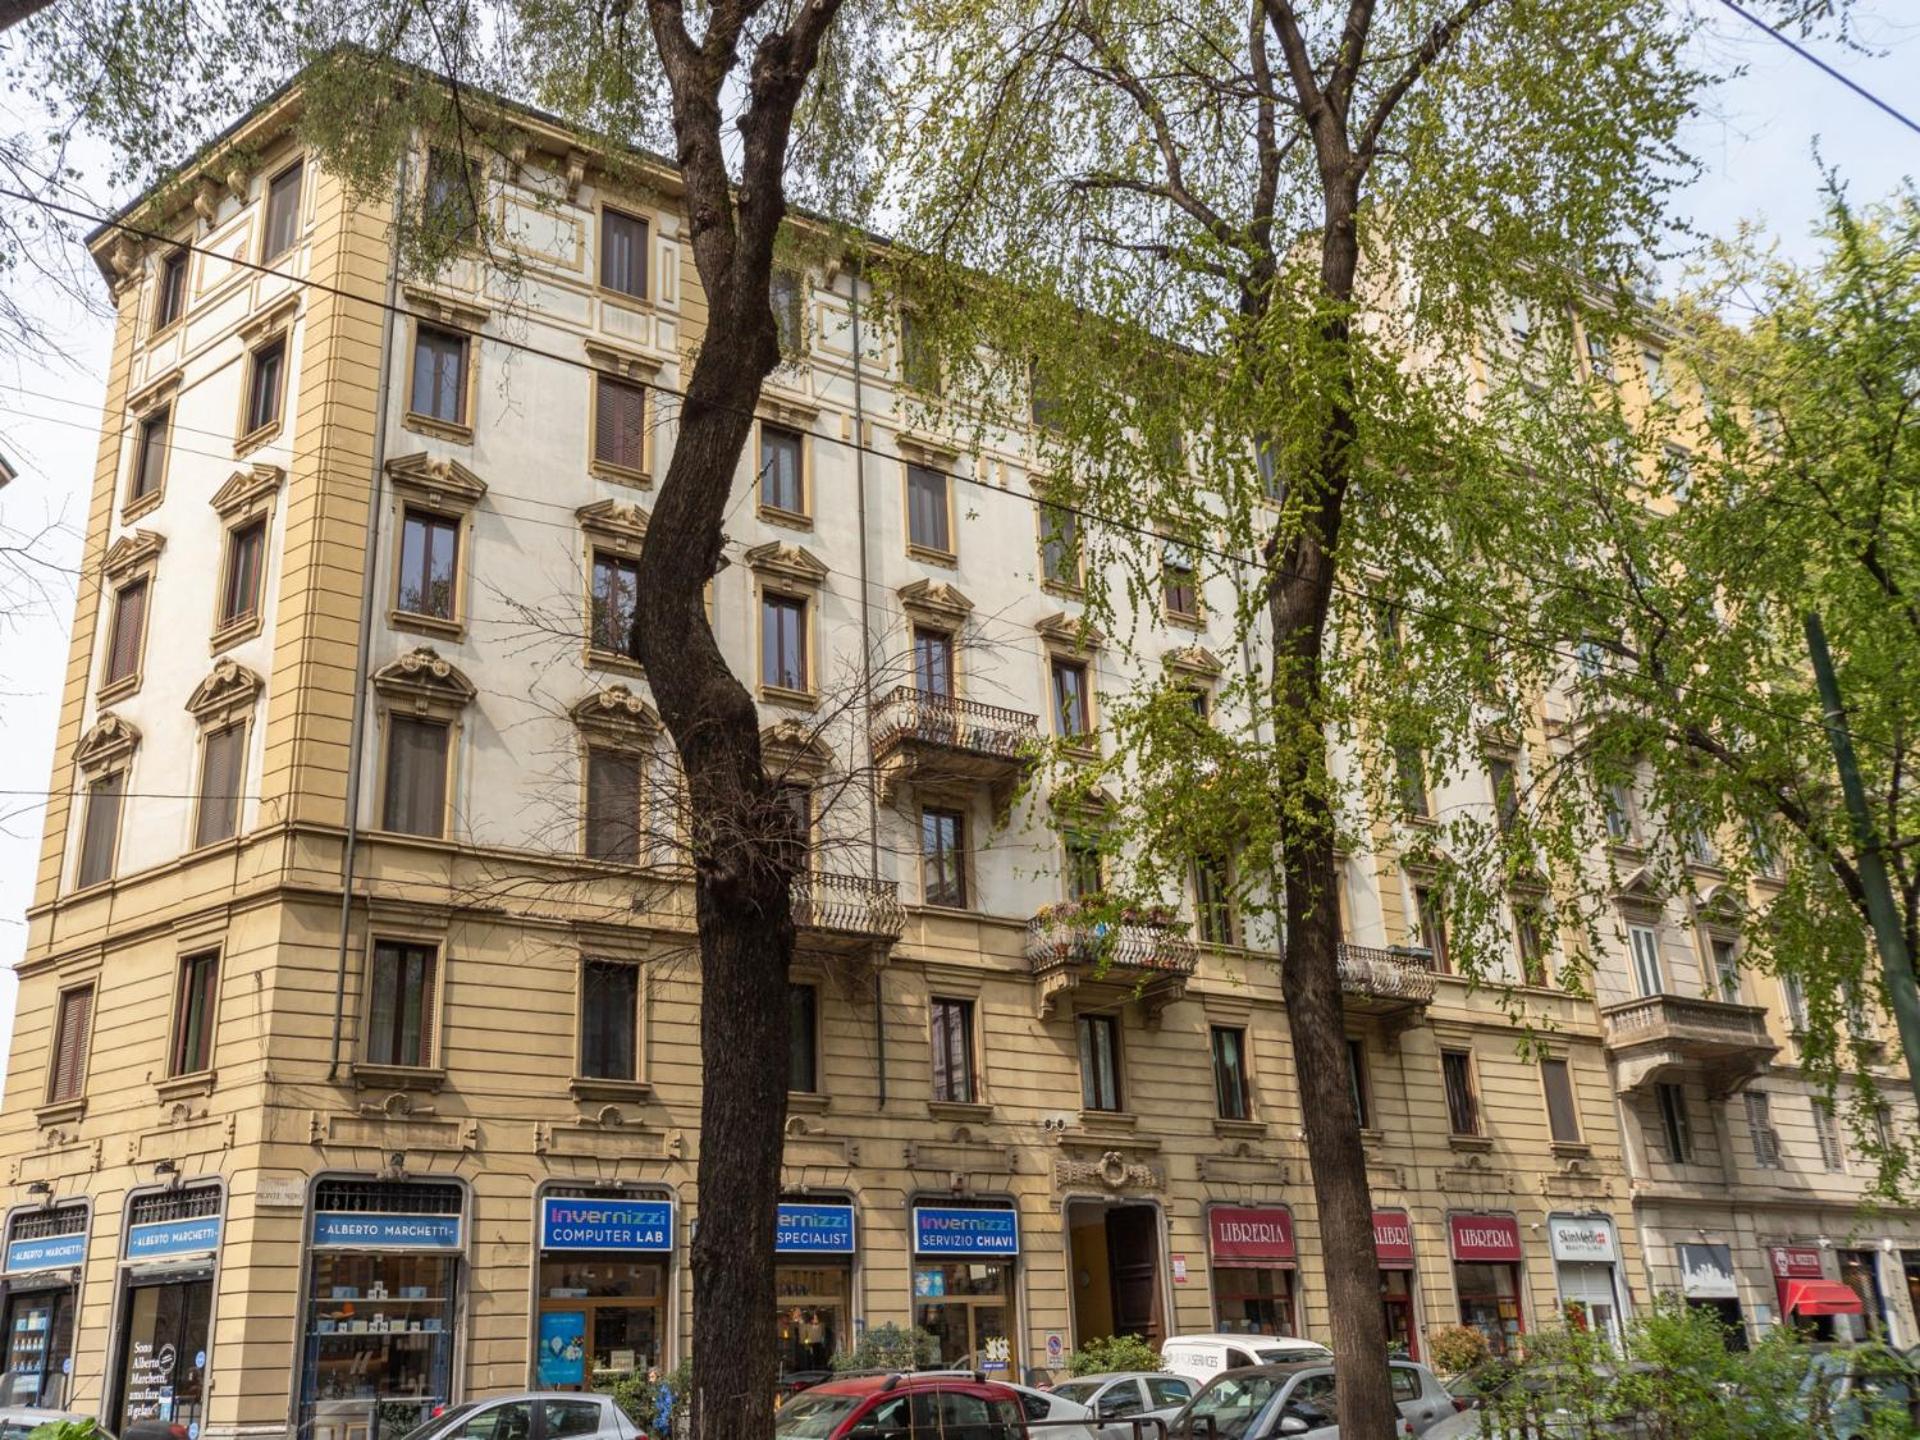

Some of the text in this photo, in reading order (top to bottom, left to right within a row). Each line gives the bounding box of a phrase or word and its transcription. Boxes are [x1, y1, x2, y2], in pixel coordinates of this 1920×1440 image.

[778, 1213, 848, 1228] ernizzi
[327, 1223, 449, 1236] ALBERTO MARCHETTI
[553, 1228, 664, 1243] COMPUTER LAB
[1220, 1223, 1285, 1243] LIBRERIA
[138, 1228, 215, 1247] ALBERTO MARCHETTI
[777, 1232, 848, 1244] SPECIALIST
[922, 1234, 1013, 1247] SERVIZIO CHIAVI
[1459, 1228, 1514, 1248] LIBRERIA
[15, 1244, 82, 1261] ALBERTO MARCHETTI
[134, 1341, 153, 1354] Sono
[132, 1356, 160, 1369] Alberto
